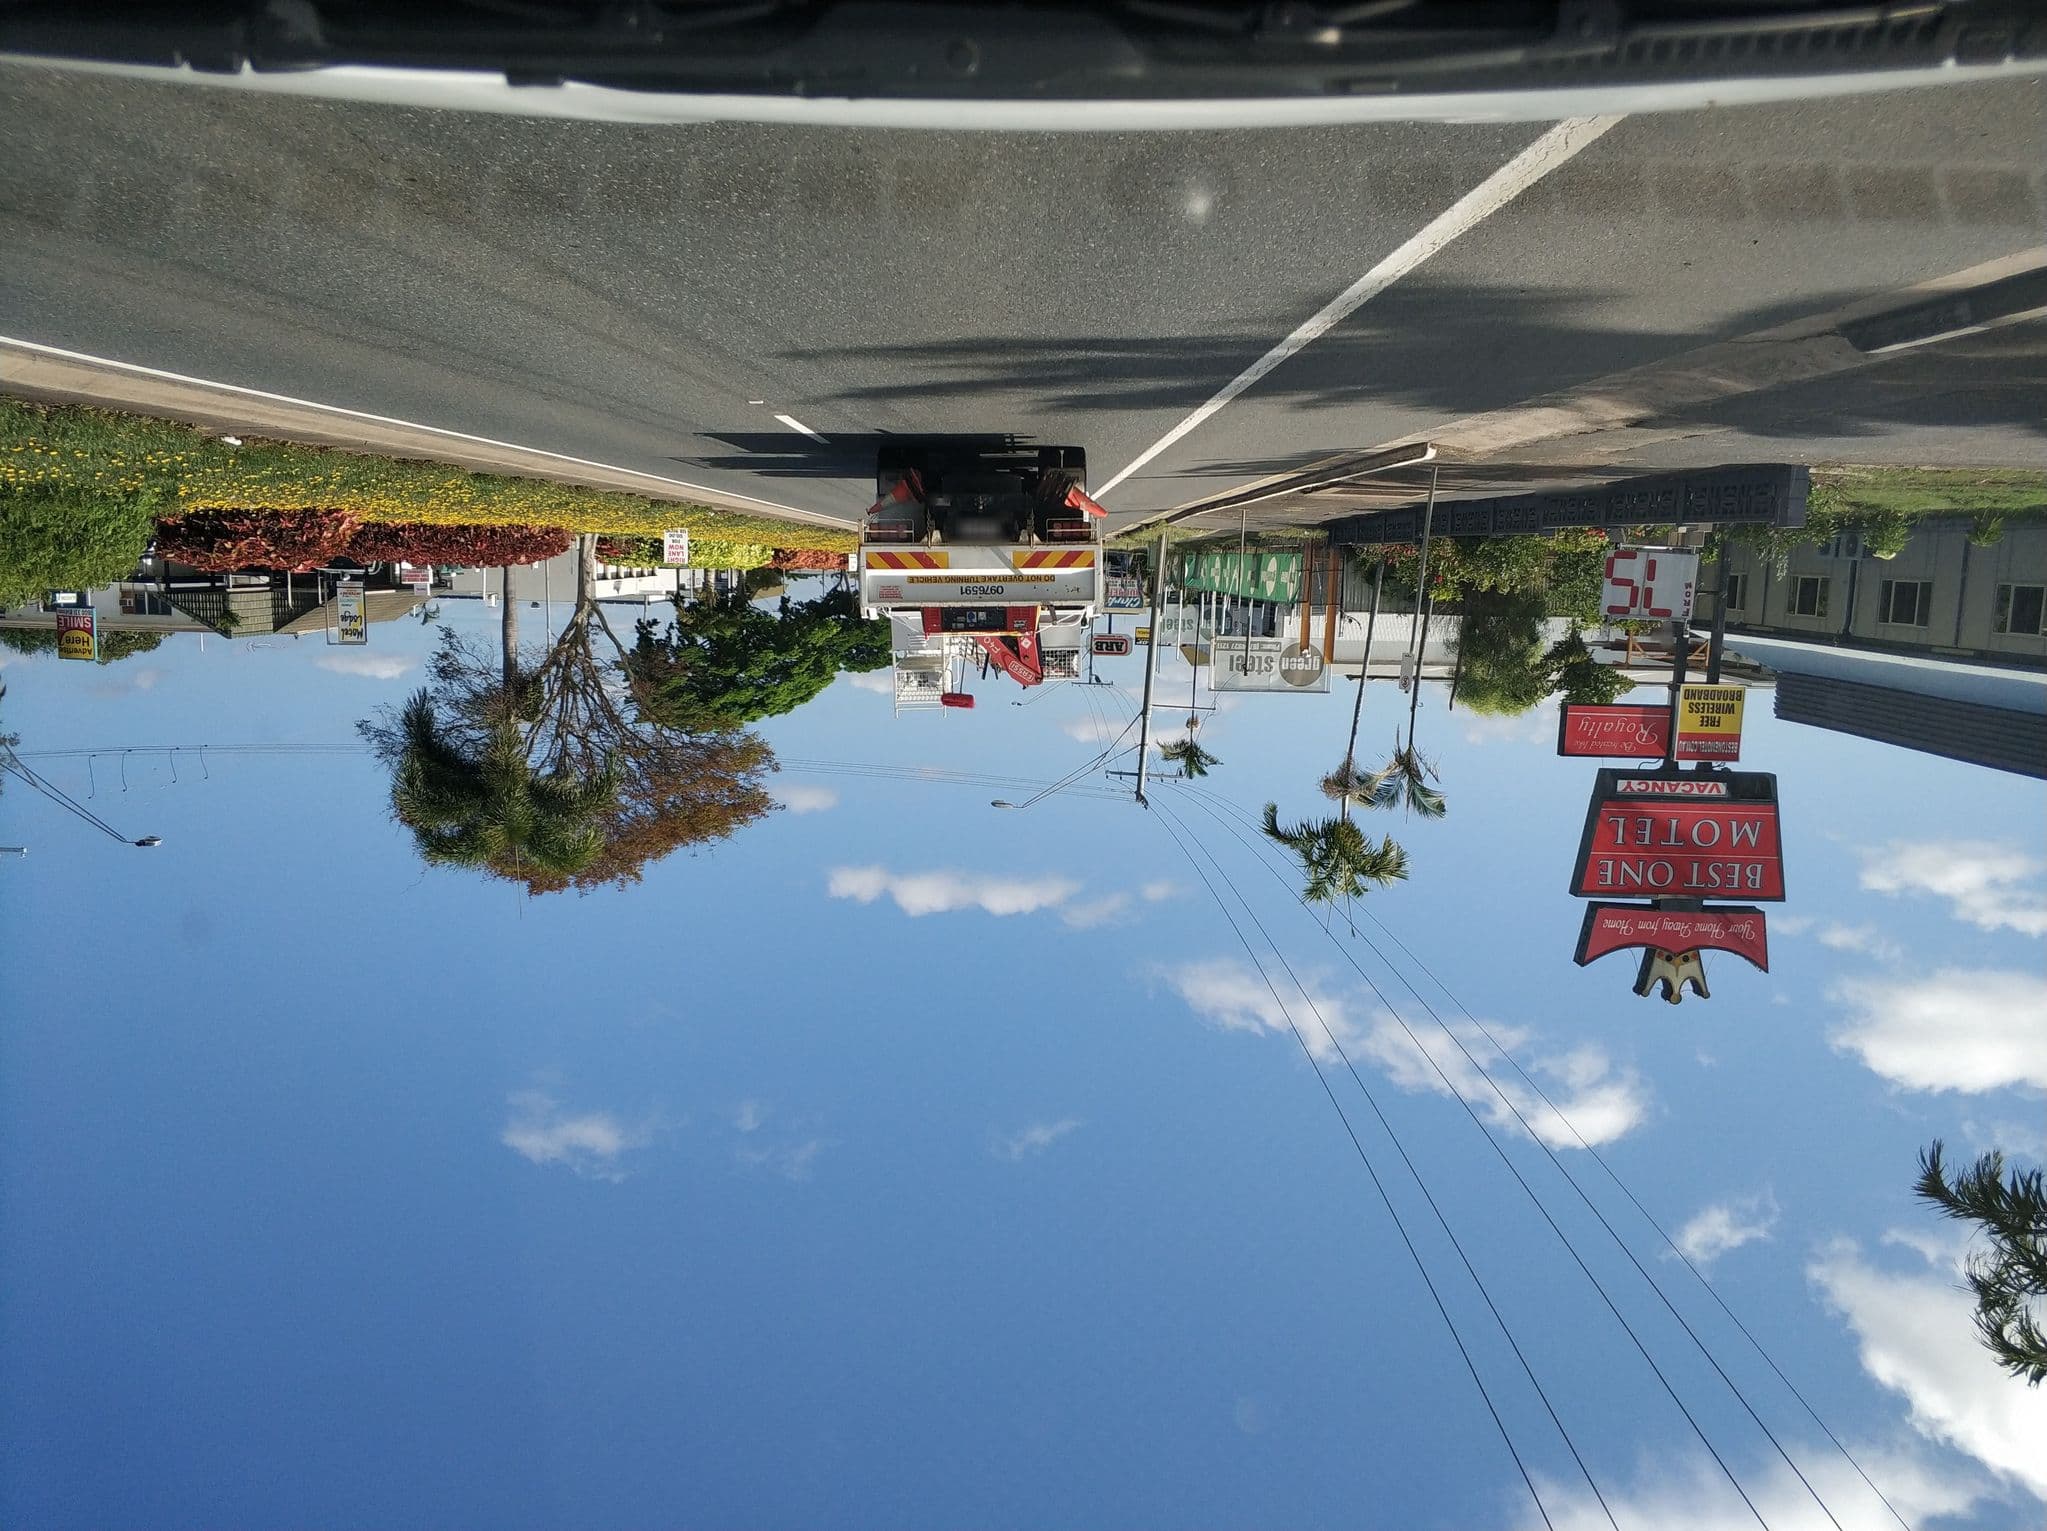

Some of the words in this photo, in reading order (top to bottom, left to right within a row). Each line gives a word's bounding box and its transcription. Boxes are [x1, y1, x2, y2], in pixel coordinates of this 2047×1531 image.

[910, 576, 942, 584] VEHICLE
[1024, 574, 1042, 582] NOT
[1043, 574, 1056, 582] DO
[1604, 550, 1672, 618] 75
[960, 586, 1004, 595] 0976591
[1108, 597, 1140, 608] Clark
[1682, 582, 1692, 617] FROM
[58, 616, 92, 628] SMILE
[340, 610, 362, 626] Lodge
[340, 628, 364, 640] Motel
[1094, 641, 1124, 652] ARB
[1010, 662, 1032, 680] FASSI
[1229, 655, 1274, 676] steel
[1281, 656, 1320, 671] green
[1684, 688, 1742, 701] BROADBAND
[1688, 702, 1735, 714] WIRELESS
[1700, 715, 1721, 728] FREE
[1578, 716, 1658, 745] Royalty
[1620, 742, 1636, 752] Be
[1621, 780, 1721, 794] VACANCY
[1608, 817, 1762, 848] MOTEL
[1598, 860, 1674, 888] ONE
[1683, 862, 1763, 889] BEST
[1602, 918, 1633, 936] Home
[1638, 918, 1660, 936] from
[1662, 918, 1692, 937] Away
[1694, 922, 1724, 939] Home
[1728, 920, 1755, 940] Your
